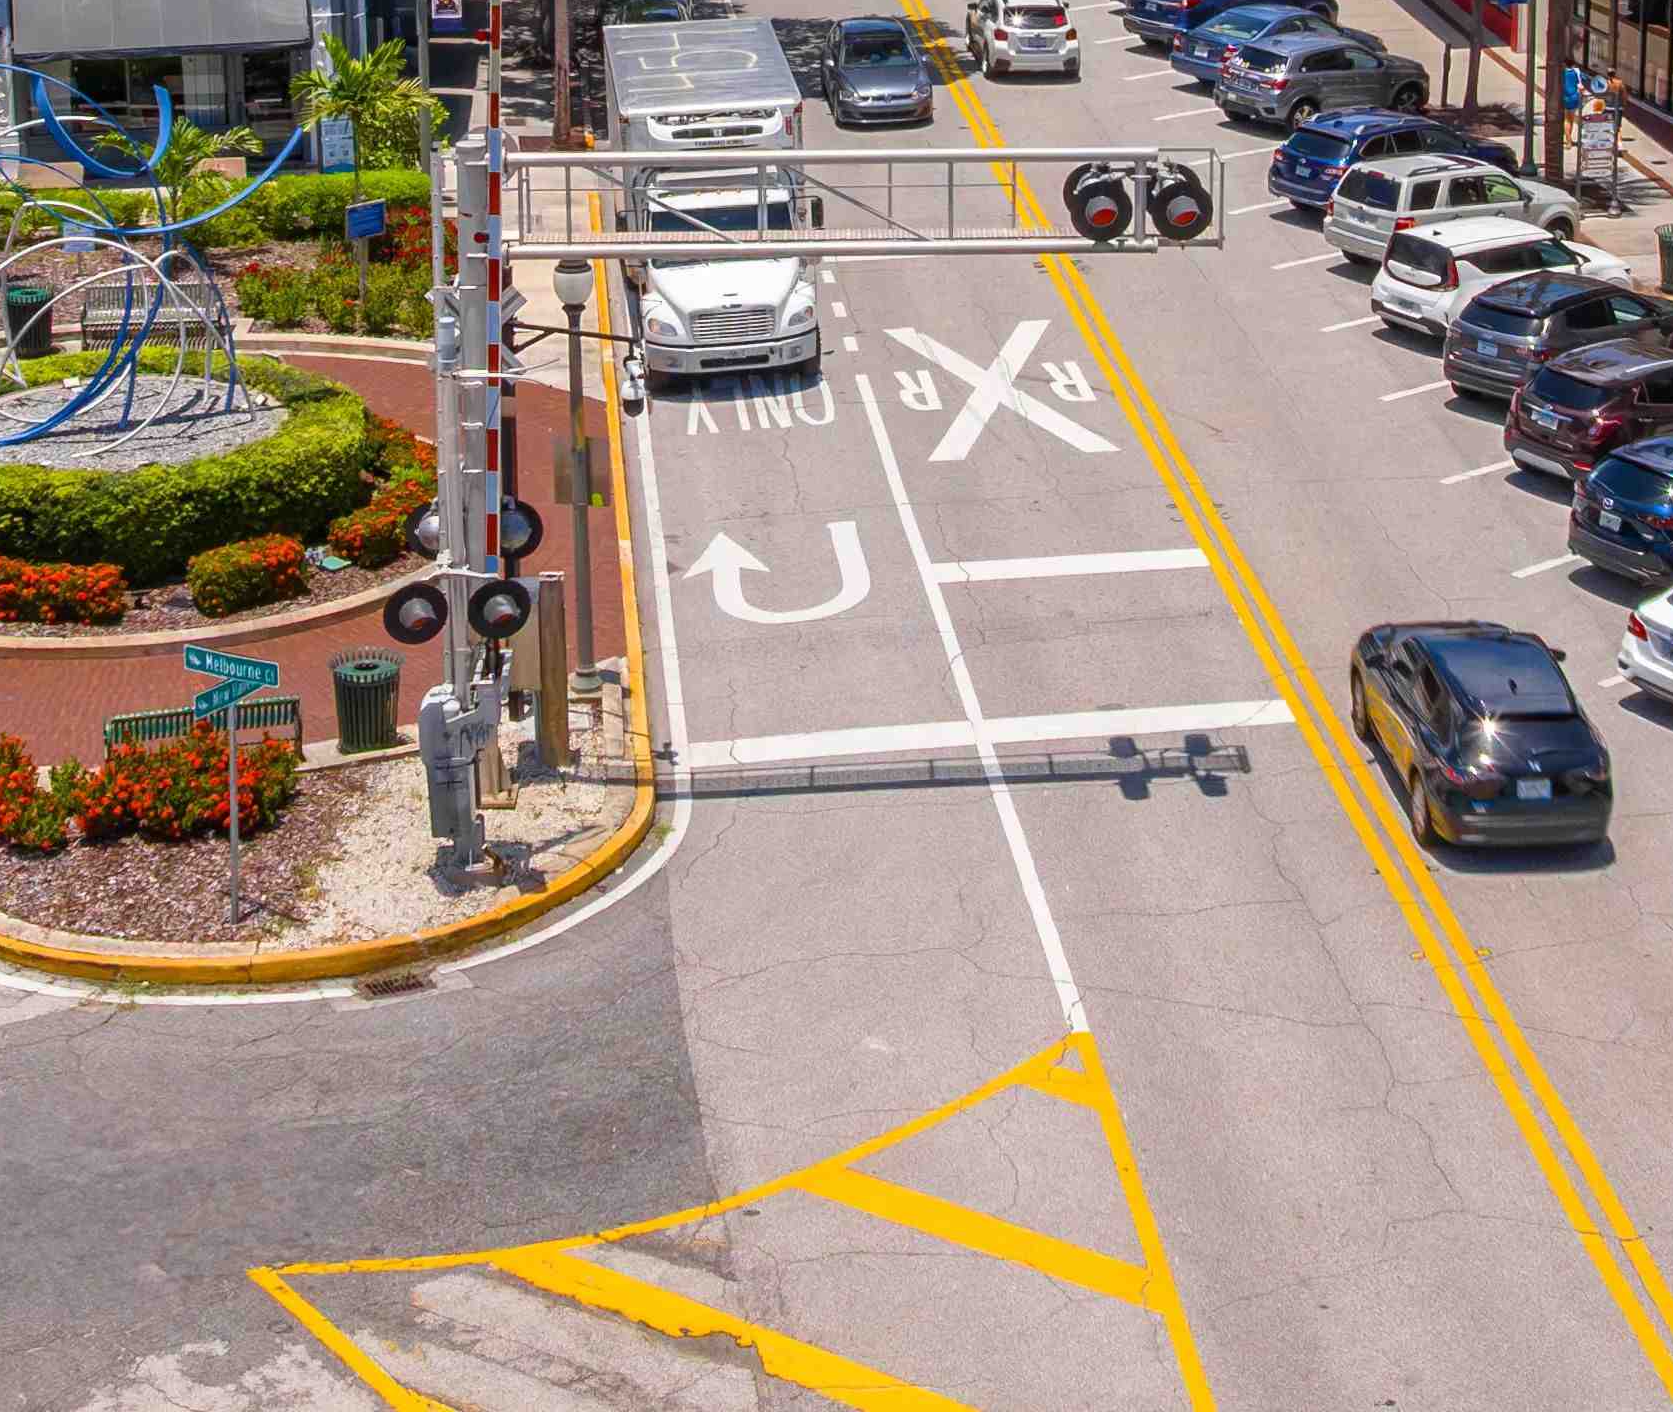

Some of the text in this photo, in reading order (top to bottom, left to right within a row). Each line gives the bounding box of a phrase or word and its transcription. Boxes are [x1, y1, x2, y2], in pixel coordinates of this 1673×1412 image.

[893, 369, 943, 411] R
[1041, 361, 1097, 402] R
[205, 652, 262, 680] Melbourne
